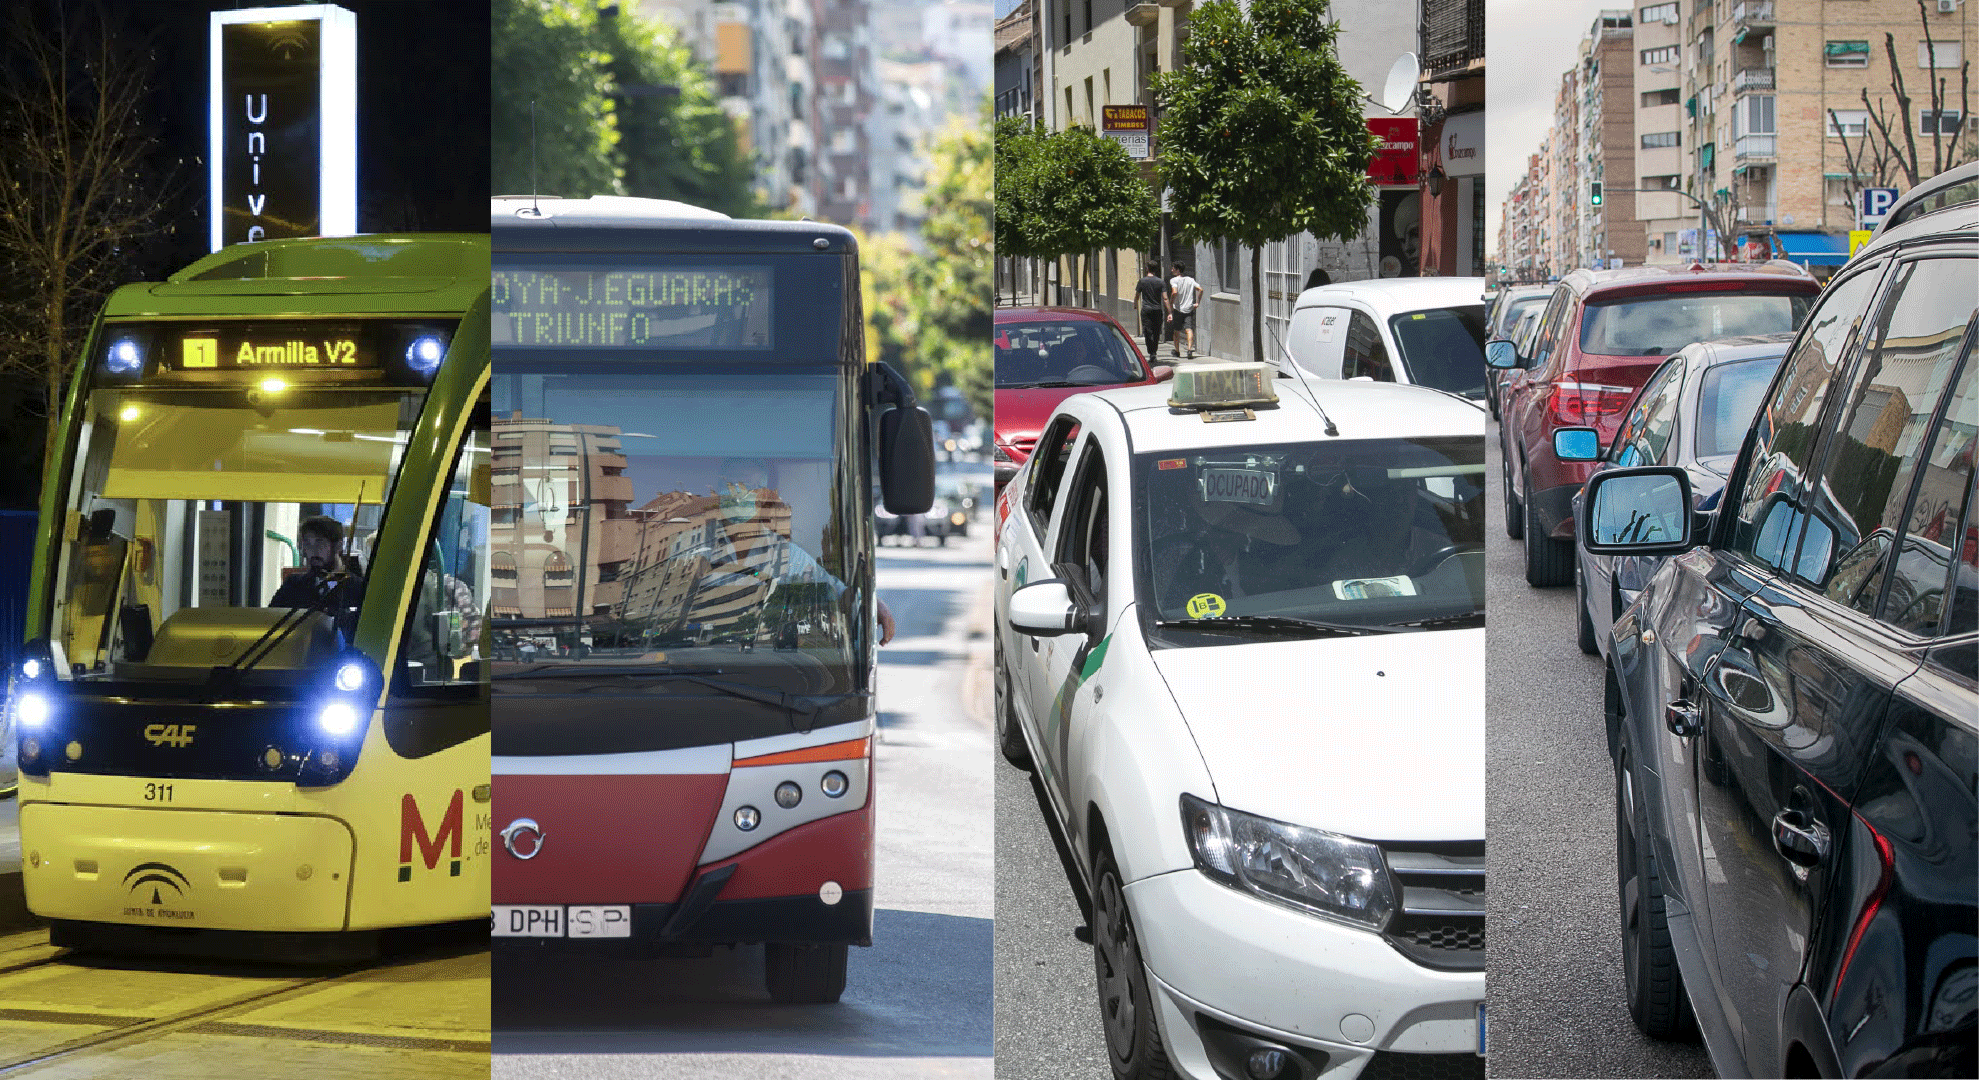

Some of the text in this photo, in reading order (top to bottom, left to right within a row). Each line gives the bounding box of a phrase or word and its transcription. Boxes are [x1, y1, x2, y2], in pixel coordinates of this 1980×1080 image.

[1118, 108, 1147, 119] TABACOS
[1872, 190, 1893, 215] P
[509, 312, 649, 344] TRIUNFO
[197, 339, 357, 364] 1 Armilla V2
[1198, 370, 1242, 397] TAXI
[1206, 474, 1269, 499] OCUPADO
[144, 724, 197, 748] CAF
[144, 782, 173, 802] 311
[510, 909, 559, 933] DPH
